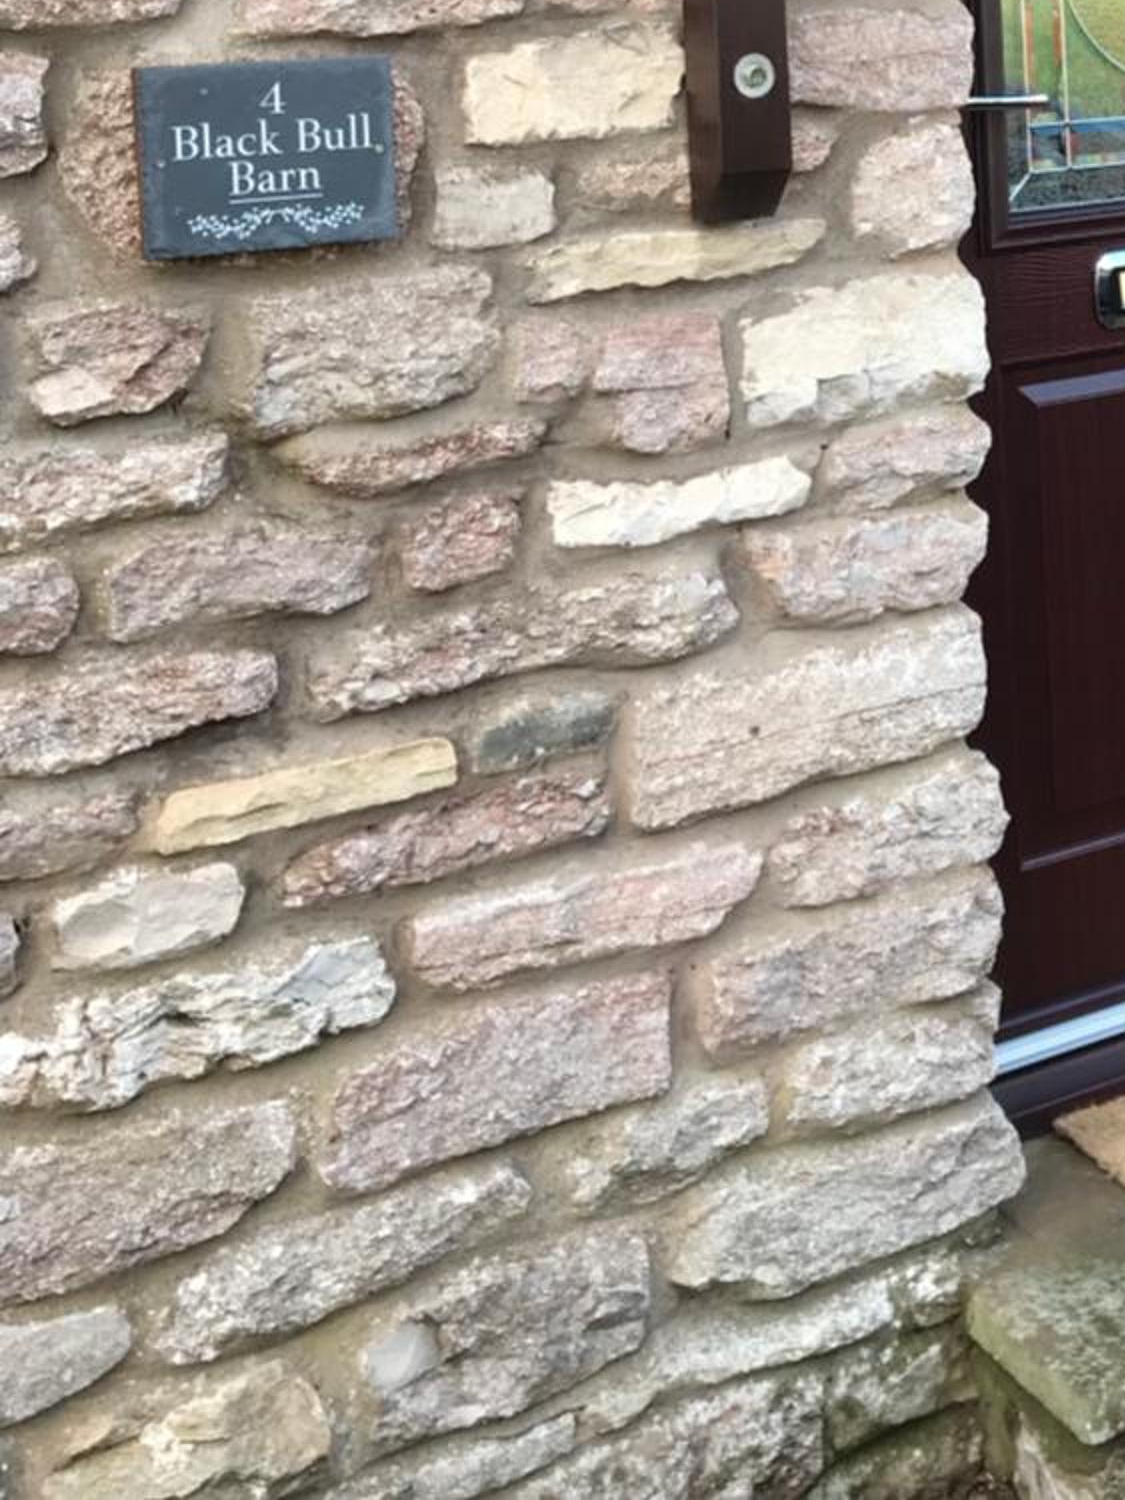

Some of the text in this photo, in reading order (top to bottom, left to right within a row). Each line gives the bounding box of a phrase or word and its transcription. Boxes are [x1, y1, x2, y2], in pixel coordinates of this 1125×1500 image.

[259, 81, 287, 115] 4
[172, 112, 373, 162] Black Bull
[229, 160, 323, 196] Barn
